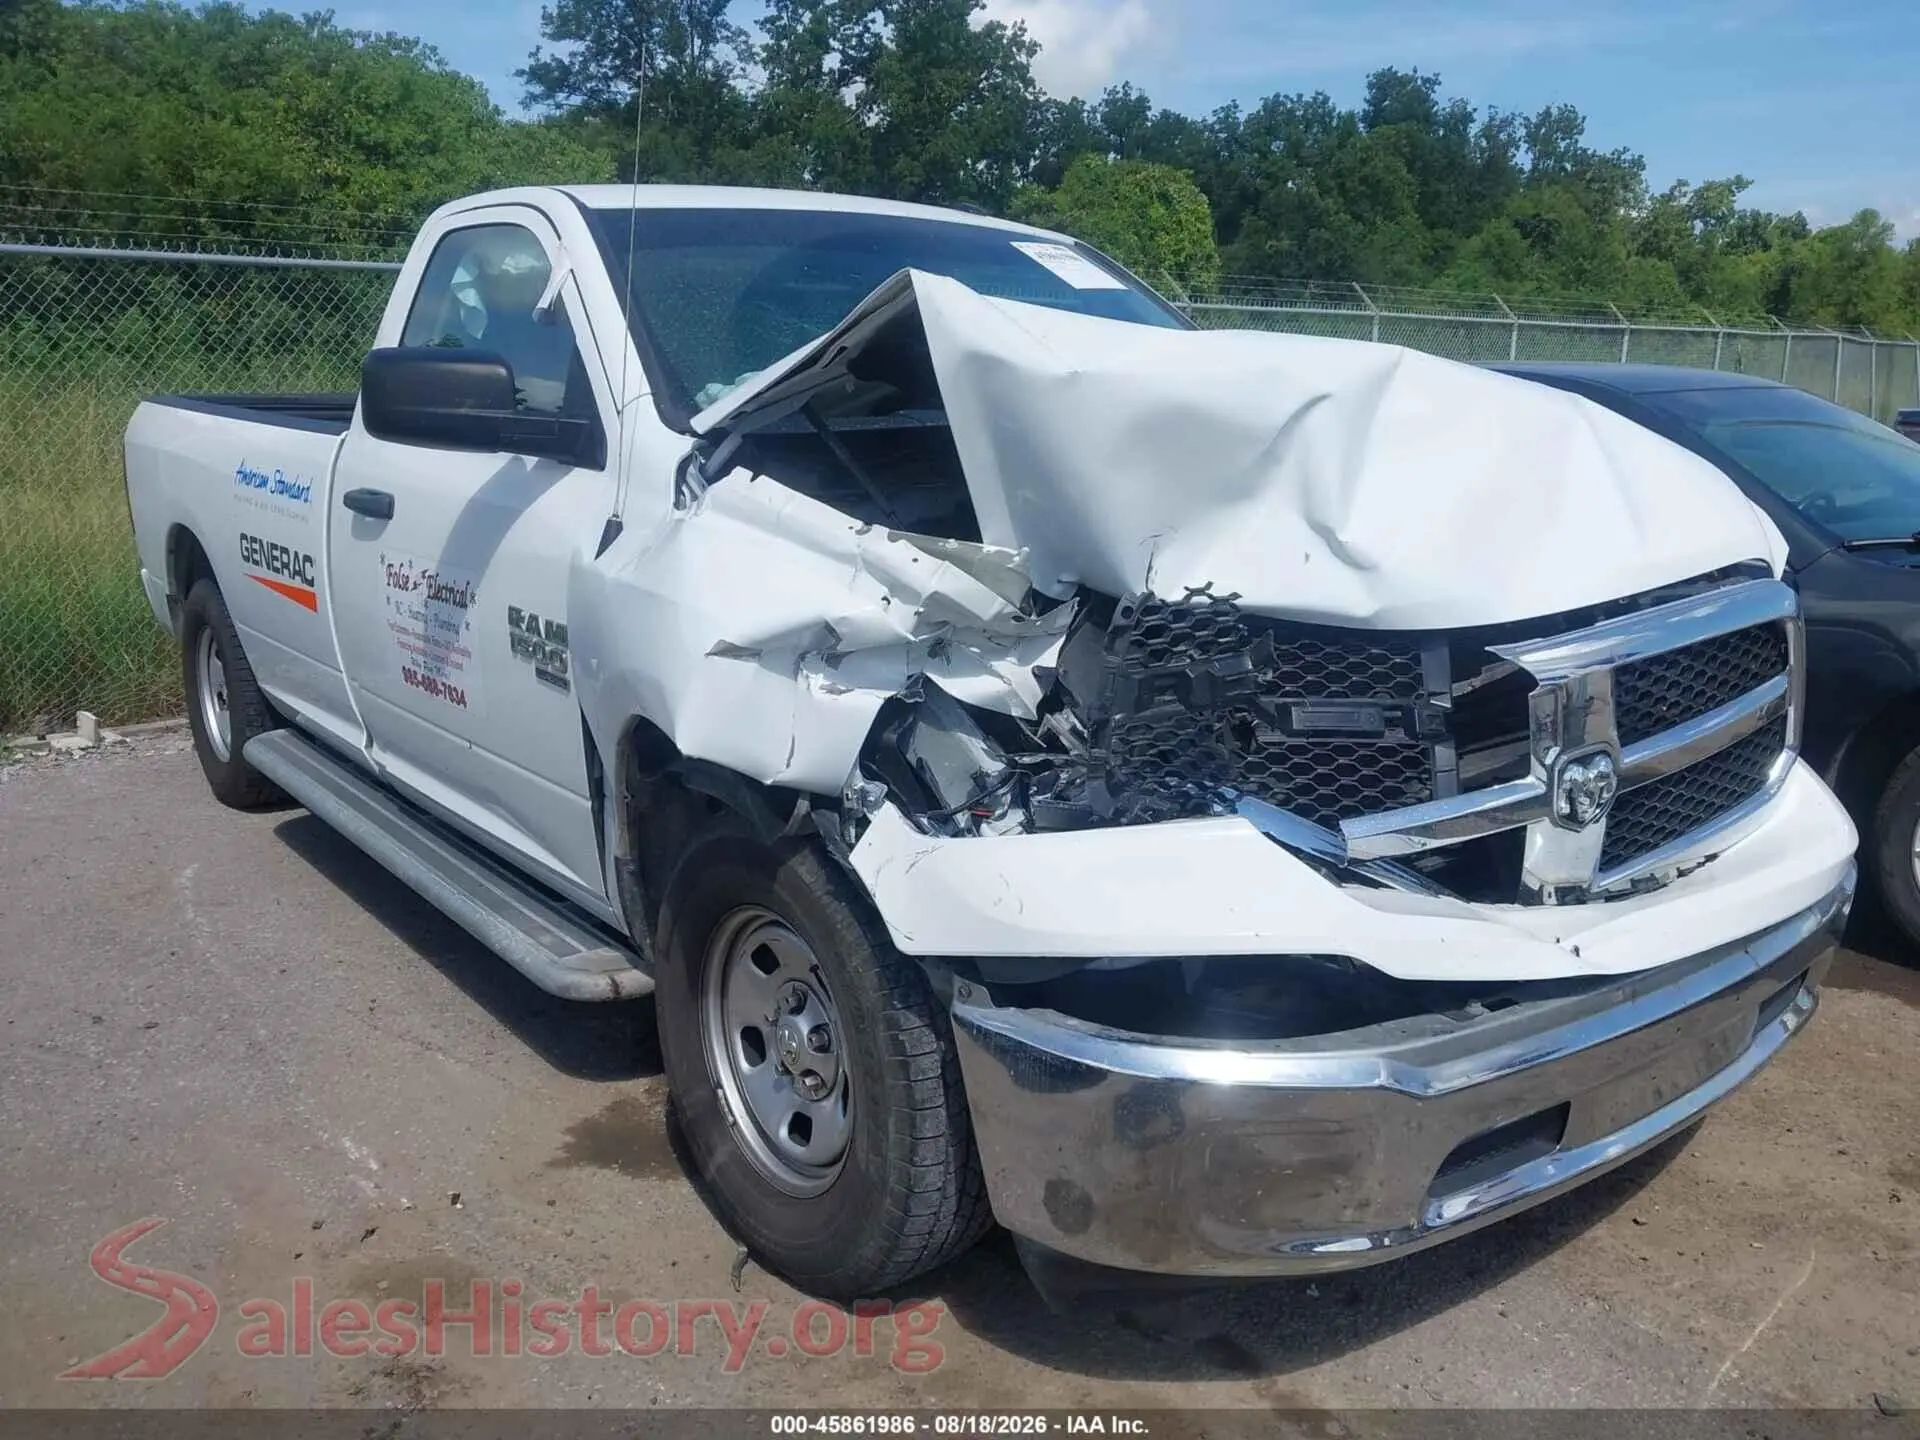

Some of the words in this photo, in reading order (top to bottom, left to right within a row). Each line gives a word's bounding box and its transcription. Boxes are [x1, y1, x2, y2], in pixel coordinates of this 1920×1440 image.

[240, 532, 314, 588] GENERAC
[425, 572, 470, 609] Electrical
[508, 605, 568, 649] RAM
